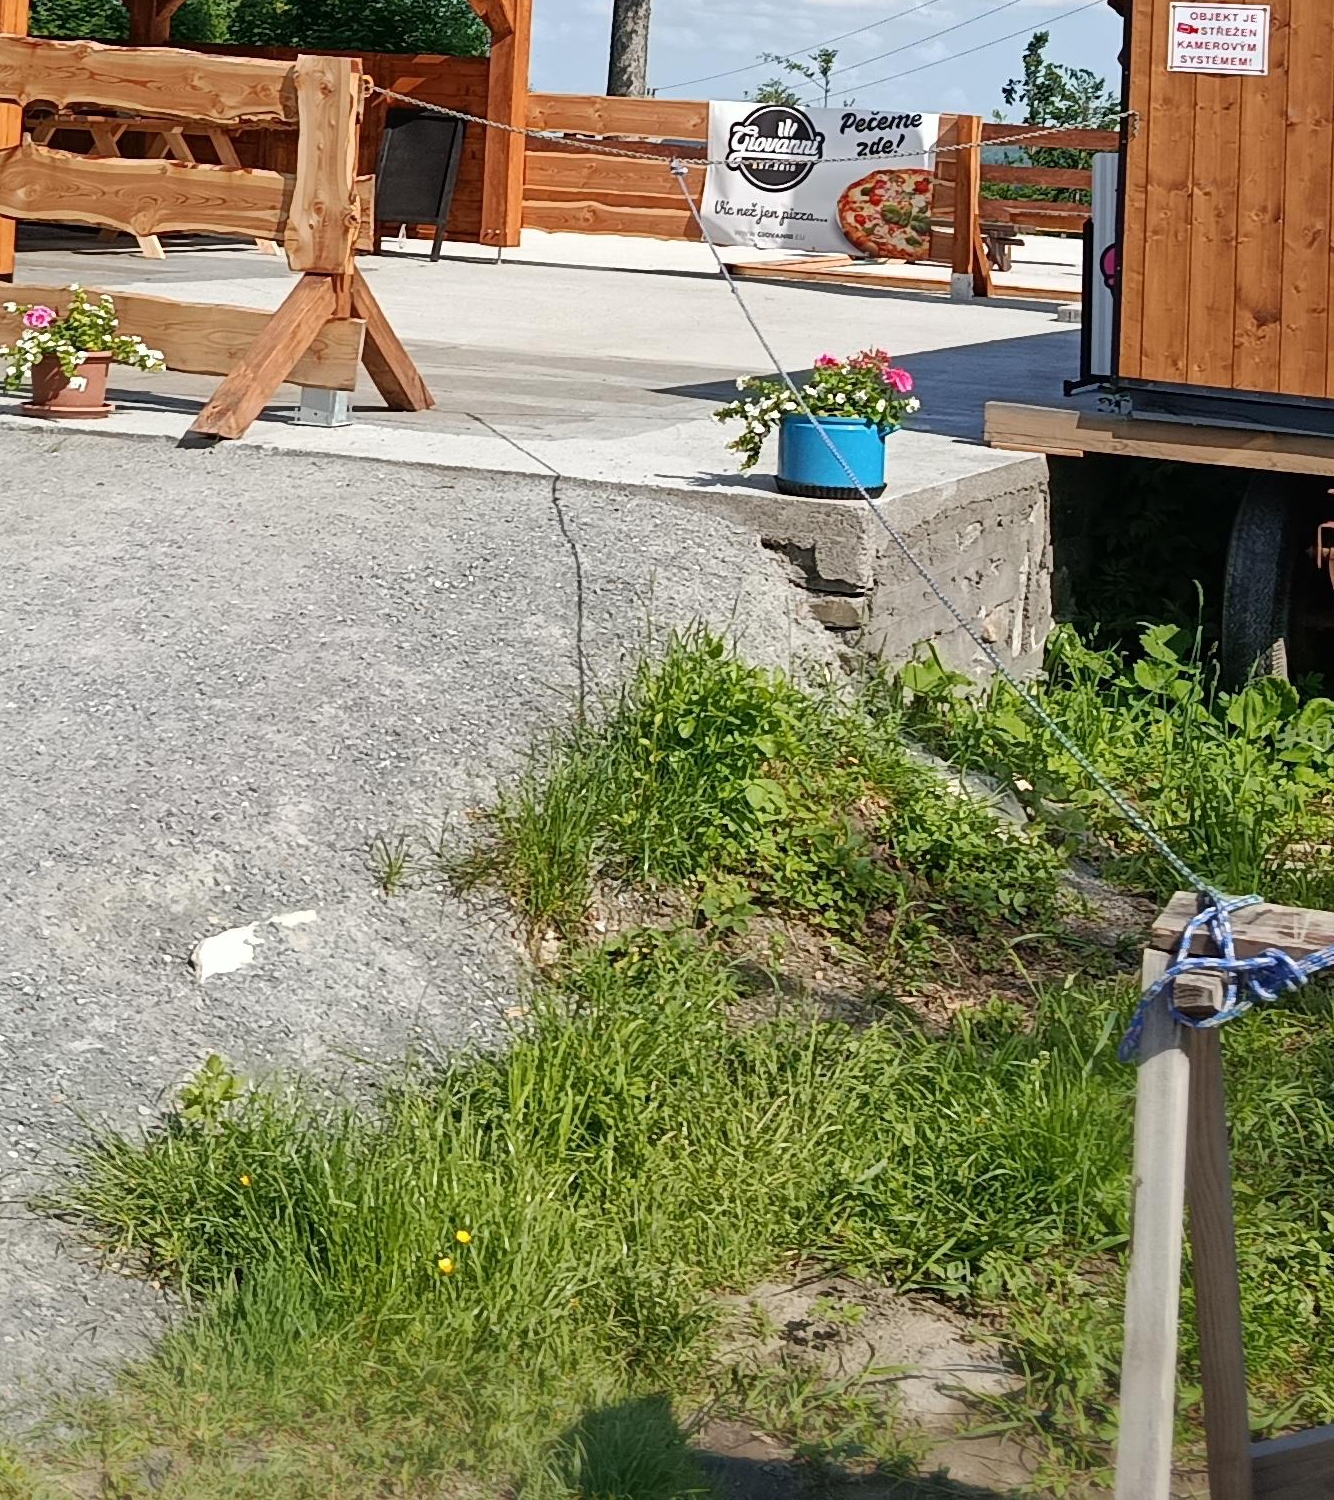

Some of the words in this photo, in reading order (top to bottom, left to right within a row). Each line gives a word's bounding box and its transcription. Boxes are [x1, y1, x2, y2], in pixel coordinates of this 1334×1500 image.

[1190, 11, 1239, 22] OBJEKT
[1242, 14, 1258, 23] JE
[1200, 26, 1257, 37] STŘEŽEN
[1177, 40, 1257, 51] KAMEROVÝM
[1180, 54, 1252, 66] SYSTÉMEM!
[840, 111, 923, 135] Pečeme
[730, 125, 822, 156] Giovanni
[856, 133, 906, 157] zde!
[714, 199, 734, 216] Víc
[736, 202, 758, 218] než
[755, 205, 780, 225] jen
